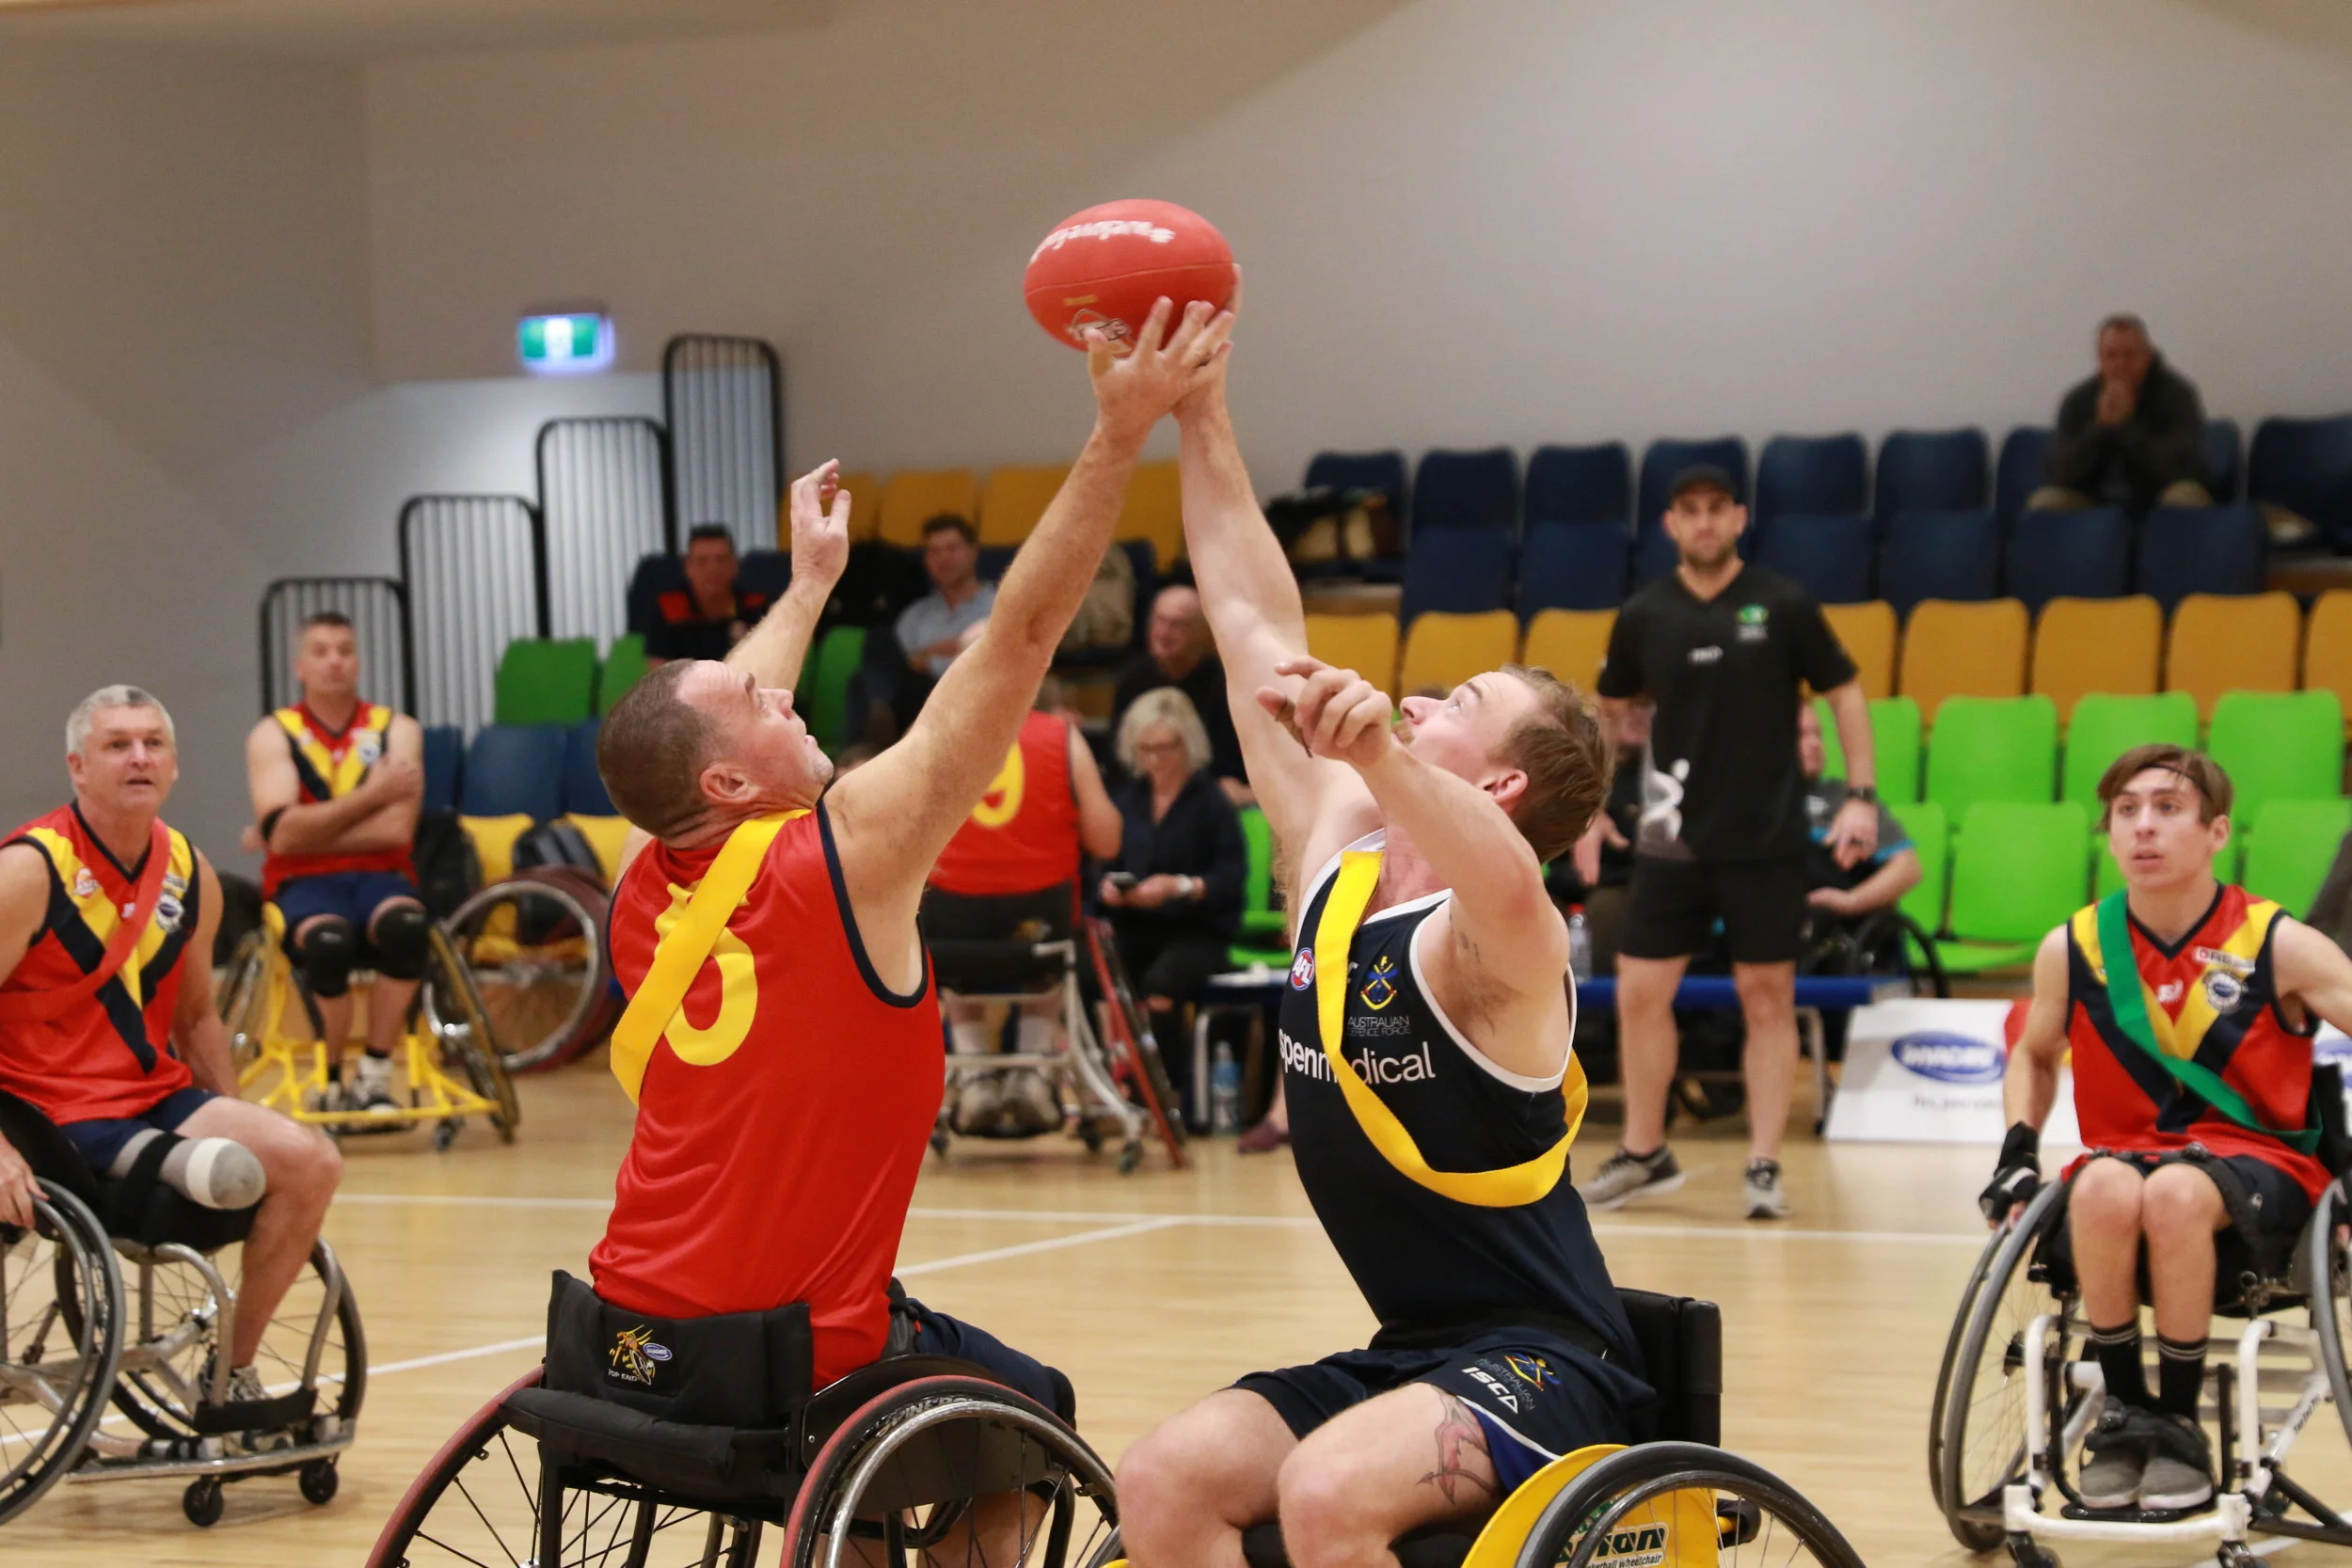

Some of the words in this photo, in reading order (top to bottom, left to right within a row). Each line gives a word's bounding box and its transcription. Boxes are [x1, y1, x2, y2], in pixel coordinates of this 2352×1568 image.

[1292, 956, 1313, 985] AFL
[1348, 1016, 1410, 1028] AUSTRALIAN
[1348, 1027, 1379, 1037] DEFENCE
[1381, 1025, 1411, 1036] FORCE
[621, 1373, 638, 1382] END
